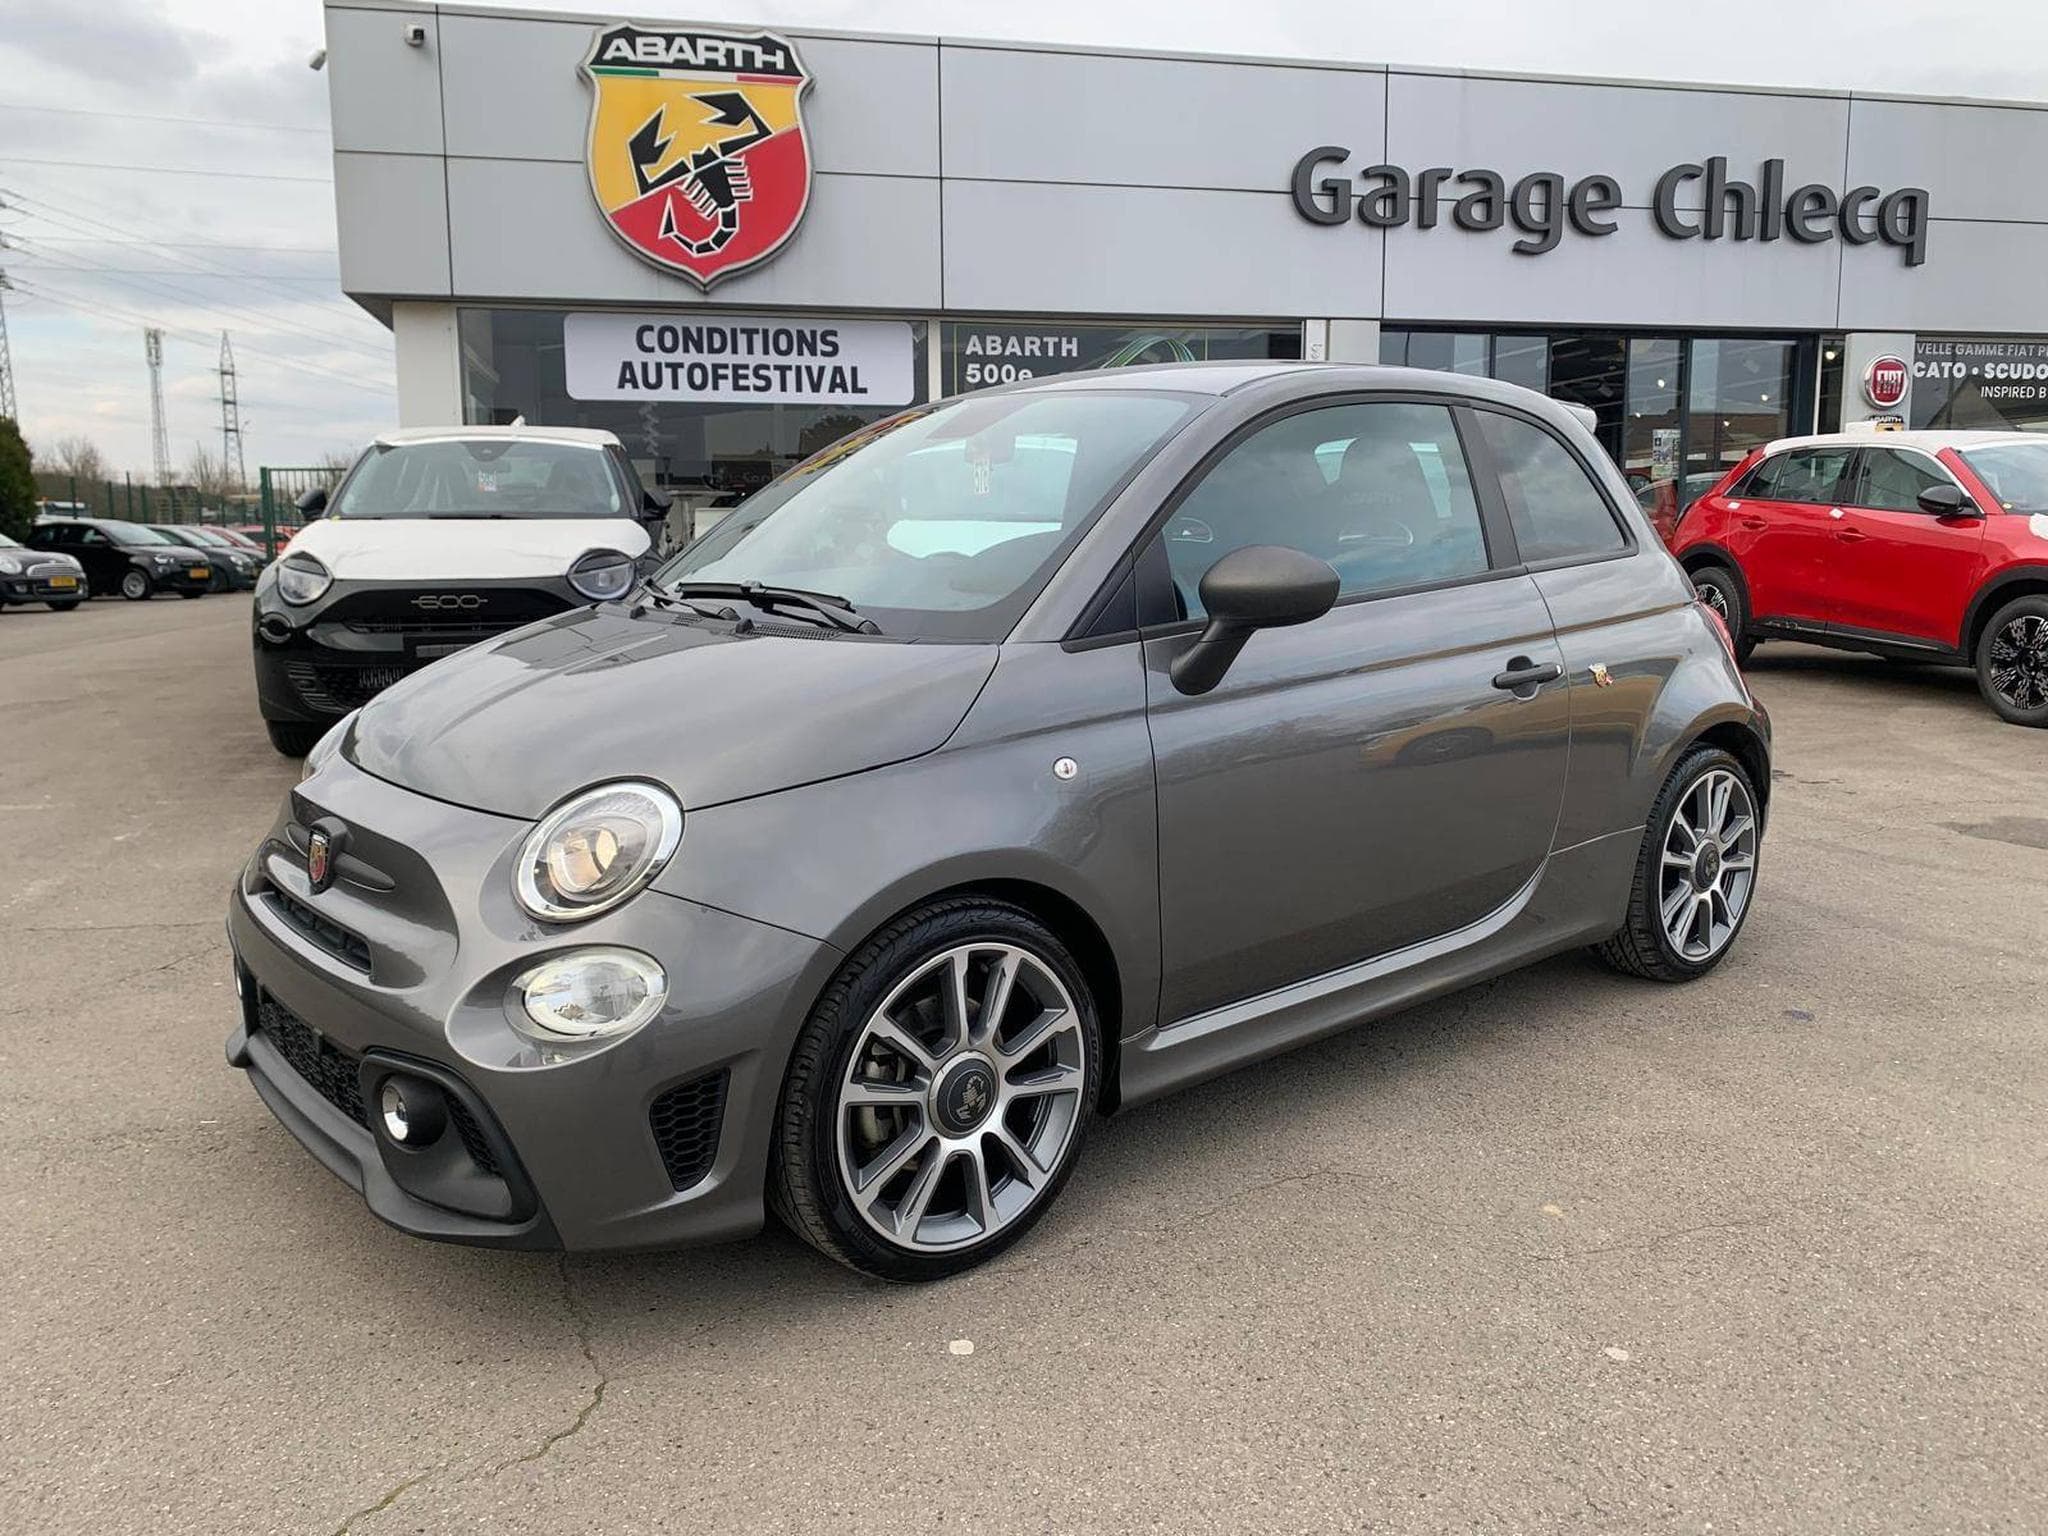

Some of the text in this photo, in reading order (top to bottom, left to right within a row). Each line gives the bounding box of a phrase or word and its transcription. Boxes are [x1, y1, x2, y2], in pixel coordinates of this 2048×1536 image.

[602, 36, 785, 70] ABARTH
[1291, 145, 1930, 267] Garage Chlecq
[635, 324, 840, 358] CONDITIONS
[965, 334, 1079, 358] ABARTH
[1955, 343, 2005, 357] GAMME
[2007, 344, 2035, 357] FIAT
[617, 360, 868, 394] AUTOFESTIVAL
[966, 363, 1033, 384] 500e
[1913, 361, 2048, 380] CATO SCUDO
[1980, 385, 2036, 399] INSPIRED
